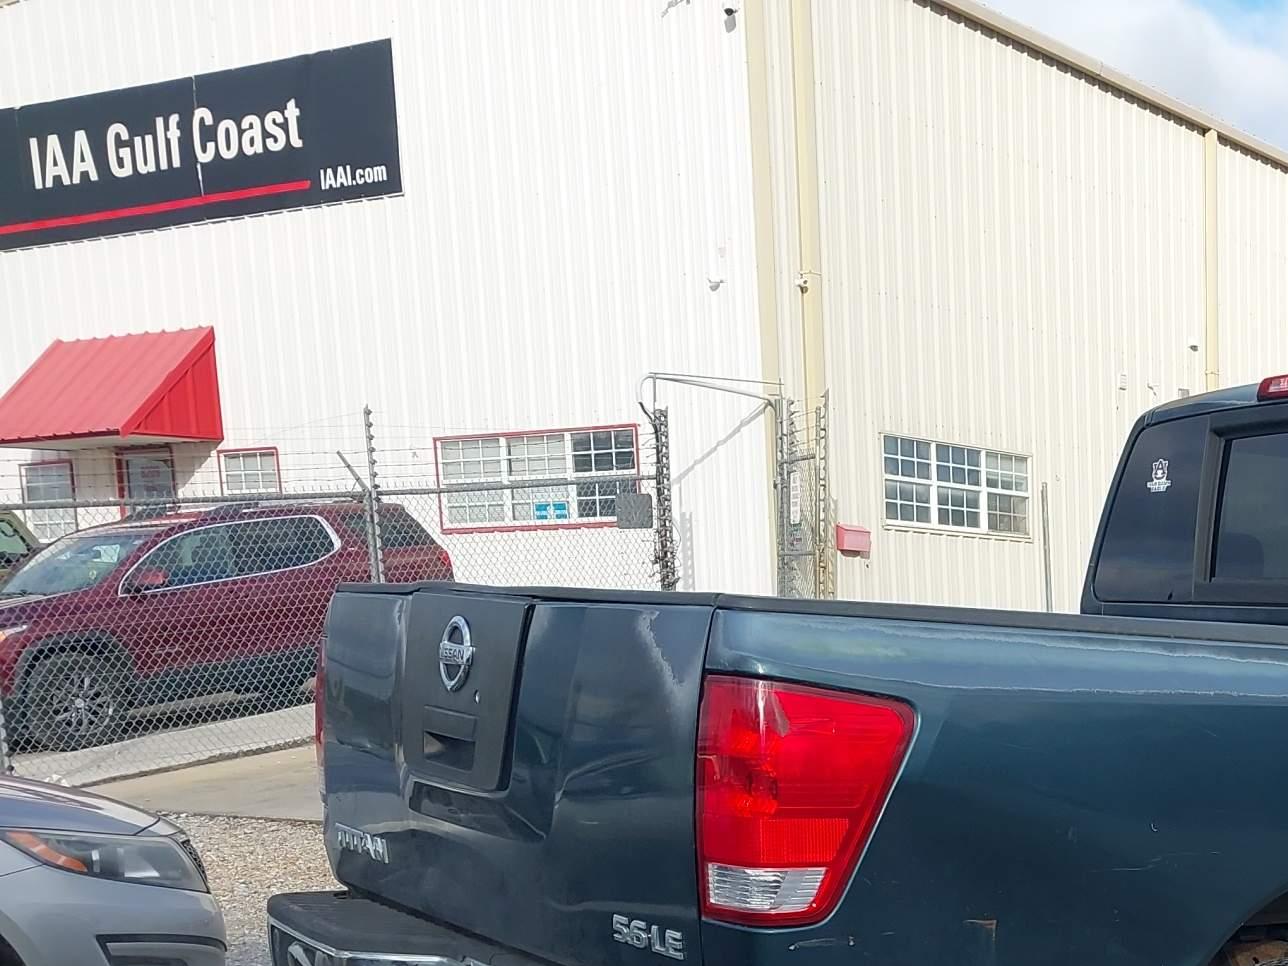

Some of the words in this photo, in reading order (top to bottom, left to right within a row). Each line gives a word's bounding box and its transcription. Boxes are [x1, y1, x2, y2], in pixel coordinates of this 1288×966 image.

[29, 129, 99, 190] IAA
[106, 113, 181, 178] Gulf
[192, 98, 303, 163] Coast
[319, 165, 387, 190] IAAI.com
